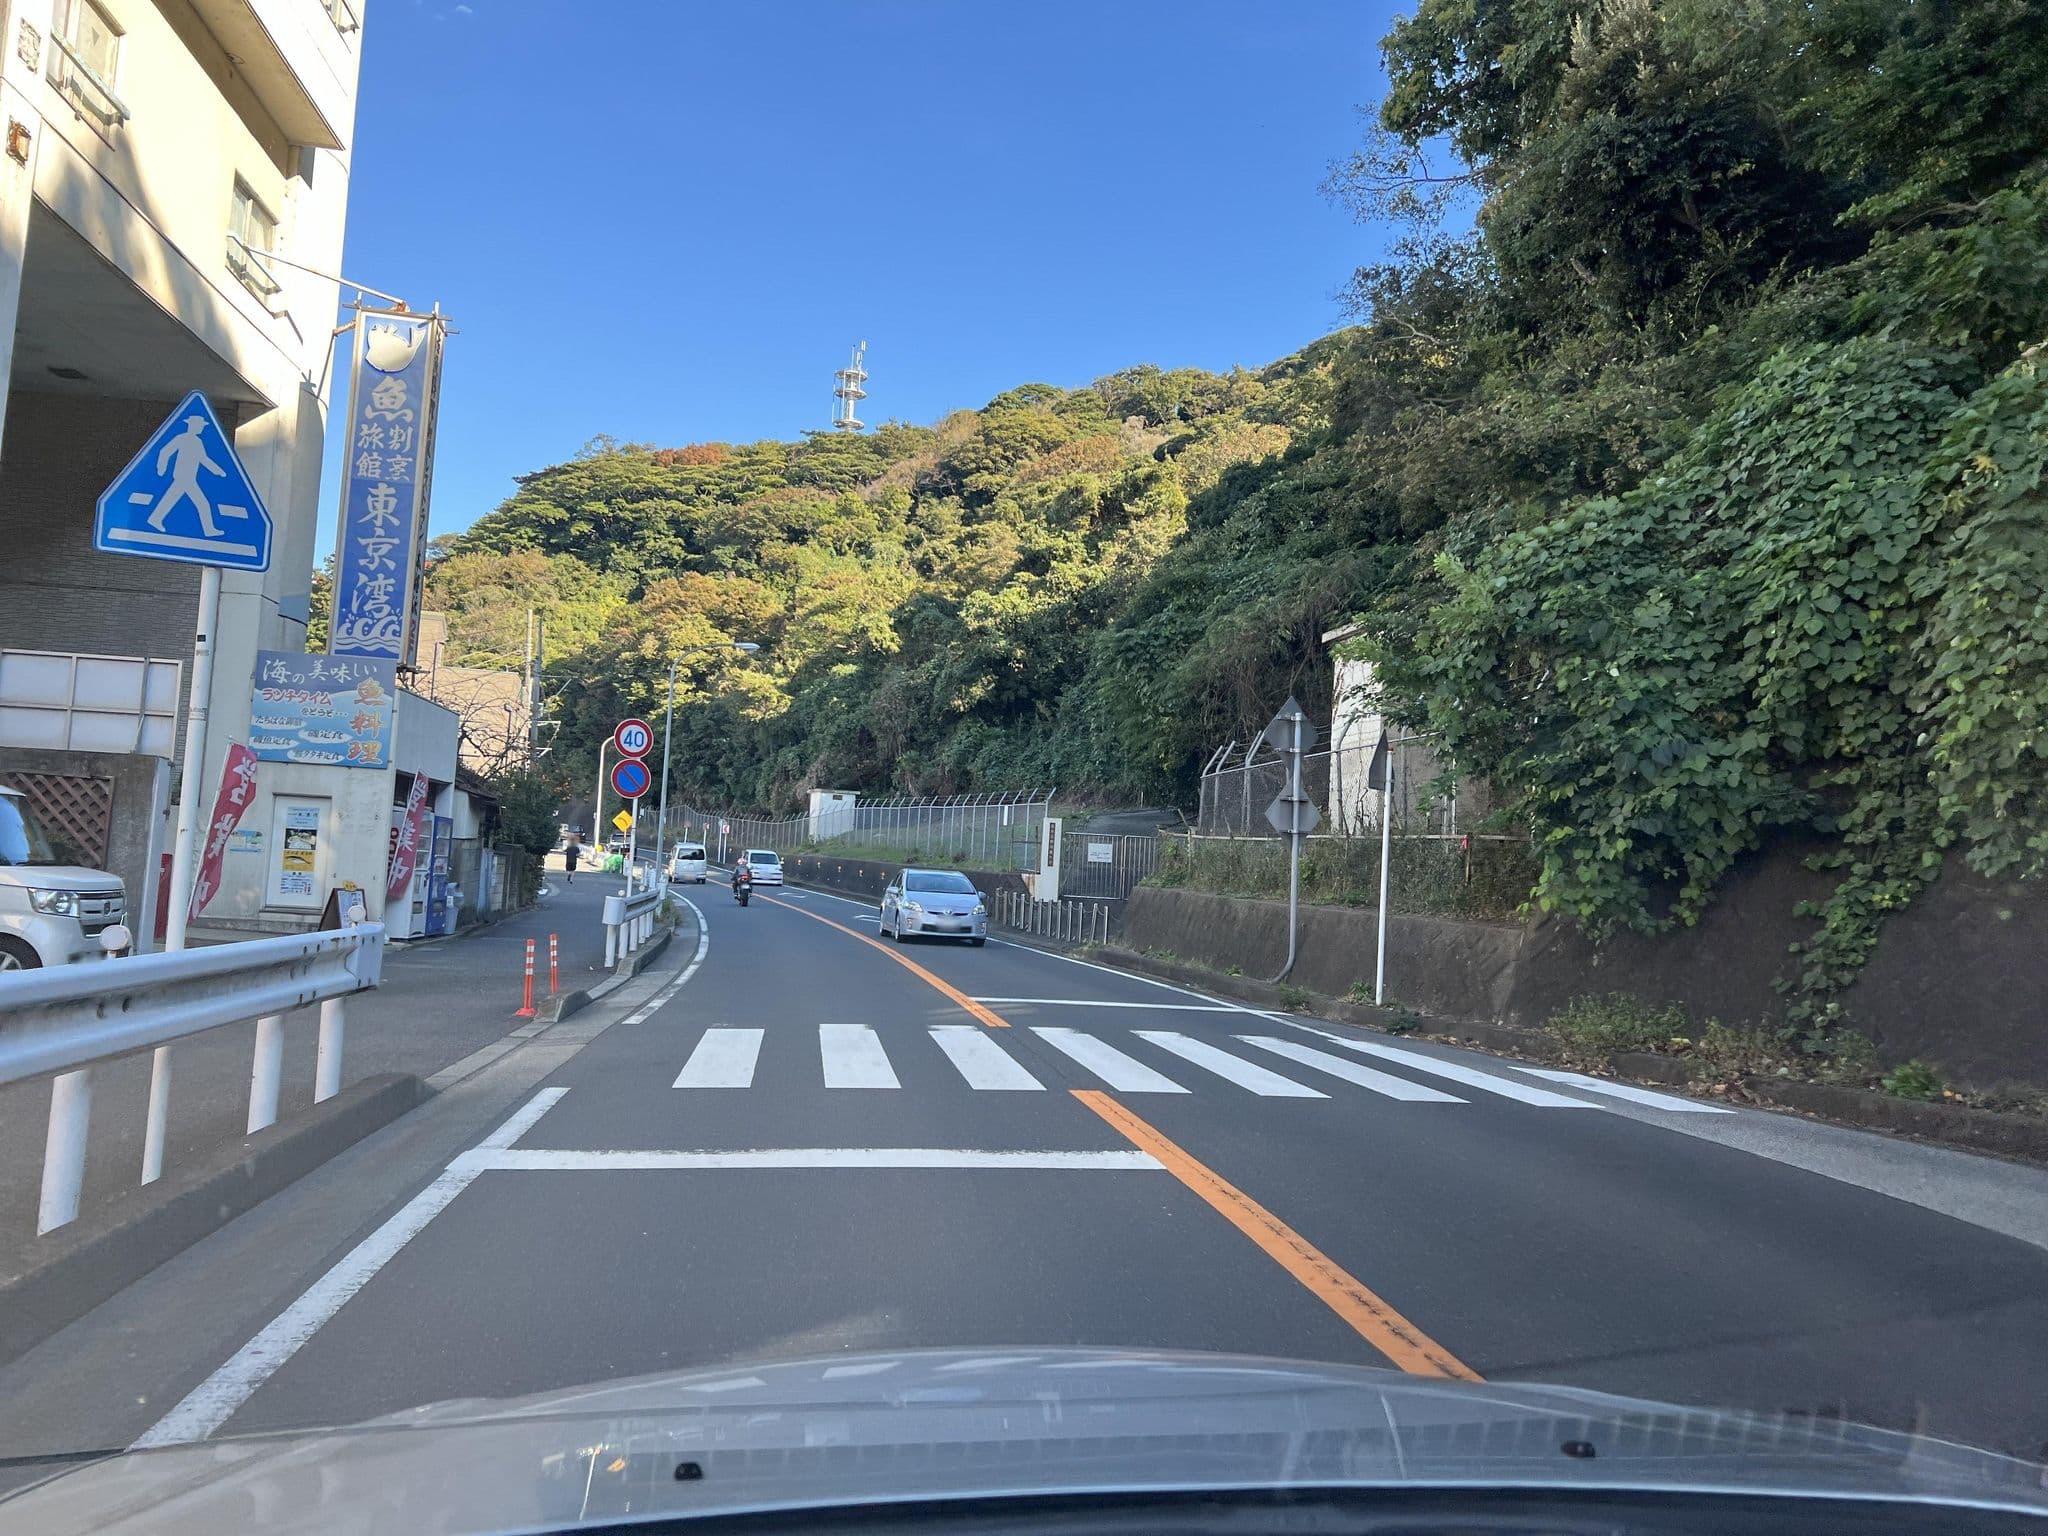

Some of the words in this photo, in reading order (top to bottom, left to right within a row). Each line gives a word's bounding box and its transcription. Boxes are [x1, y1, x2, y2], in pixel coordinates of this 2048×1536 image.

[365, 375, 414, 422] 魚
[356, 422, 385, 479] 旅館
[352, 482, 401, 619] 東京湾
[262, 688, 333, 706] ランチタイム
[263, 659, 378, 685] 海の美味しい
[346, 677, 386, 765] 魚料理
[623, 730, 645, 748] 40
[389, 778, 428, 889] 営業中
